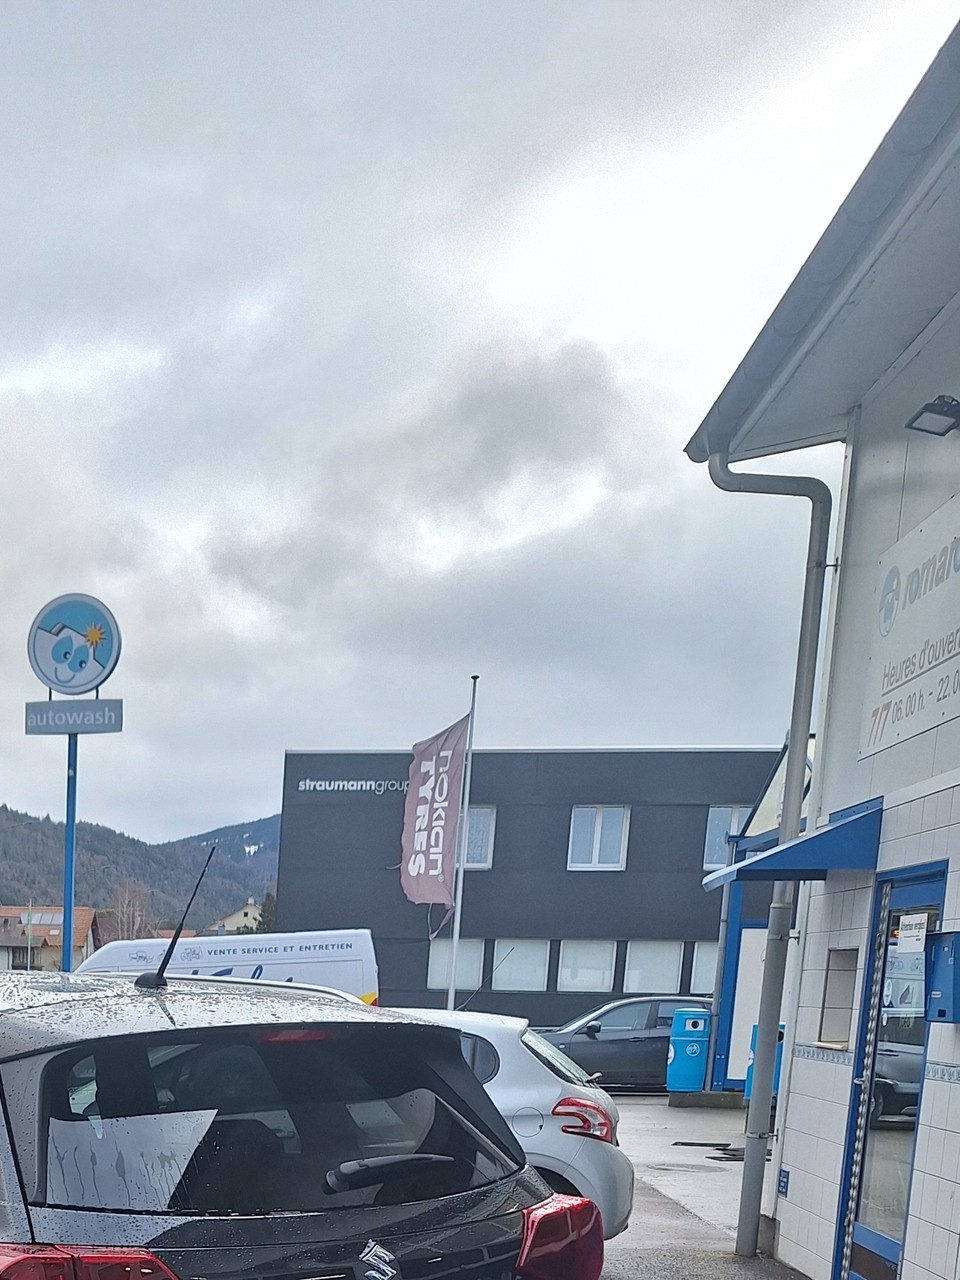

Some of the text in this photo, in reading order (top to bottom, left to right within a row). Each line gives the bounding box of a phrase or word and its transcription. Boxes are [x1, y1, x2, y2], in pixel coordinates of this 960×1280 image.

[881, 626, 960, 692] Heures d'ouver
[935, 668, 960, 703] 22.0
[28, 706, 116, 727] autowash
[408, 755, 436, 877] TYRES
[207, 948, 238, 956] VENTE
[241, 946, 280, 955] SERVICE
[298, 942, 353, 951] ENTRETIEN
